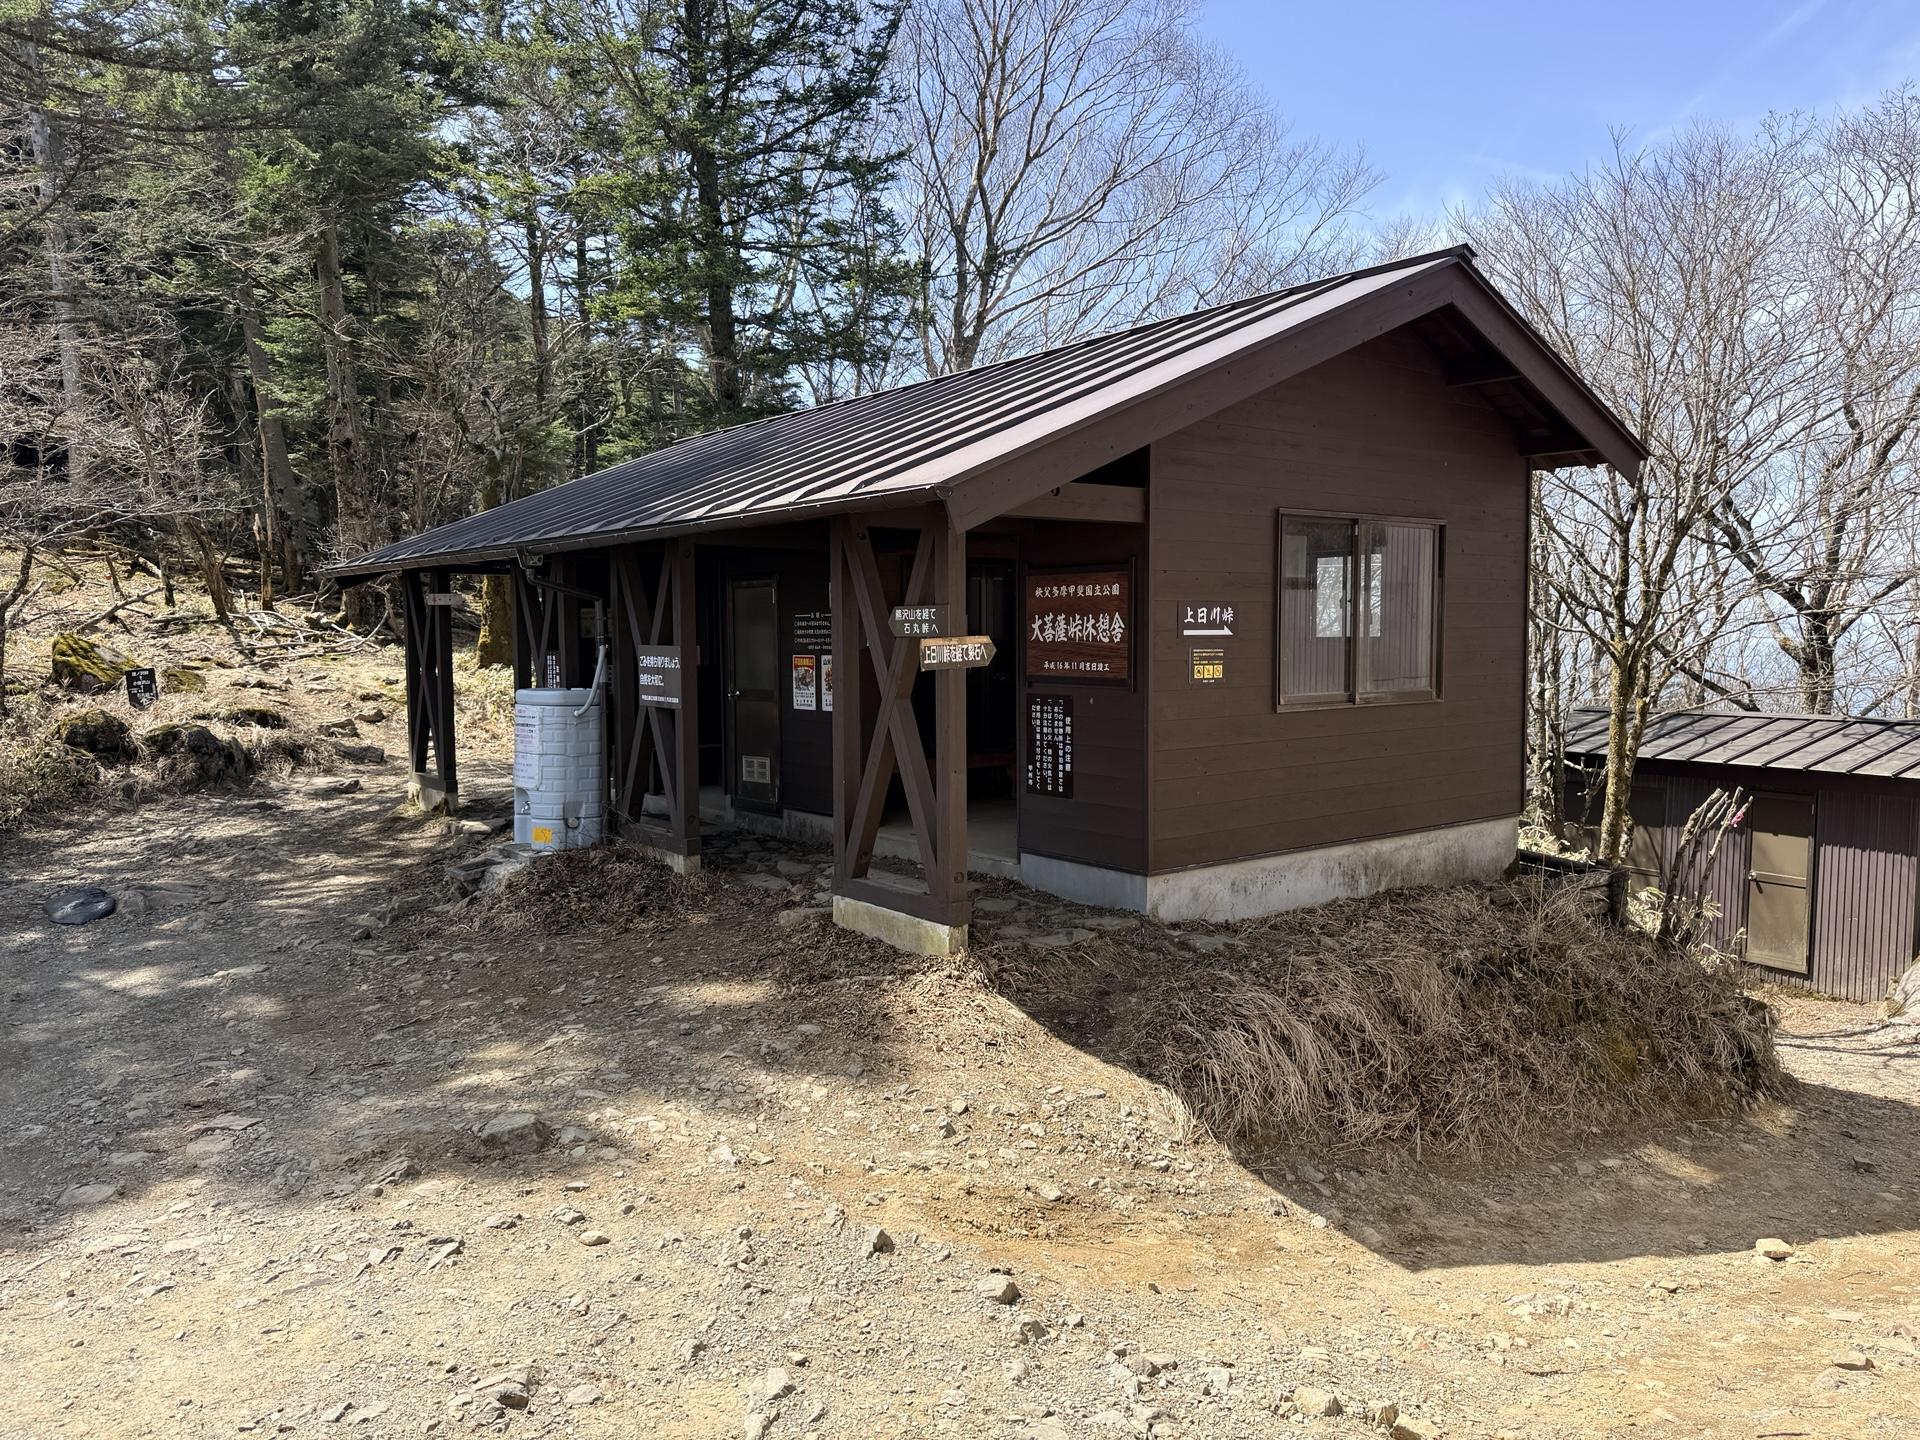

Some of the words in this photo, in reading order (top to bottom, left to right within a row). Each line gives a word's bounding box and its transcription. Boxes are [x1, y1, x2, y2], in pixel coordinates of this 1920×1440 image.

[1035, 583, 1120, 598] 秩父多摩甲斐国立公園
[895, 608, 936, 620] 熊沢山を経て
[1183, 606, 1234, 624] 上日川峠
[904, 622, 939, 634] 石丸峠へ
